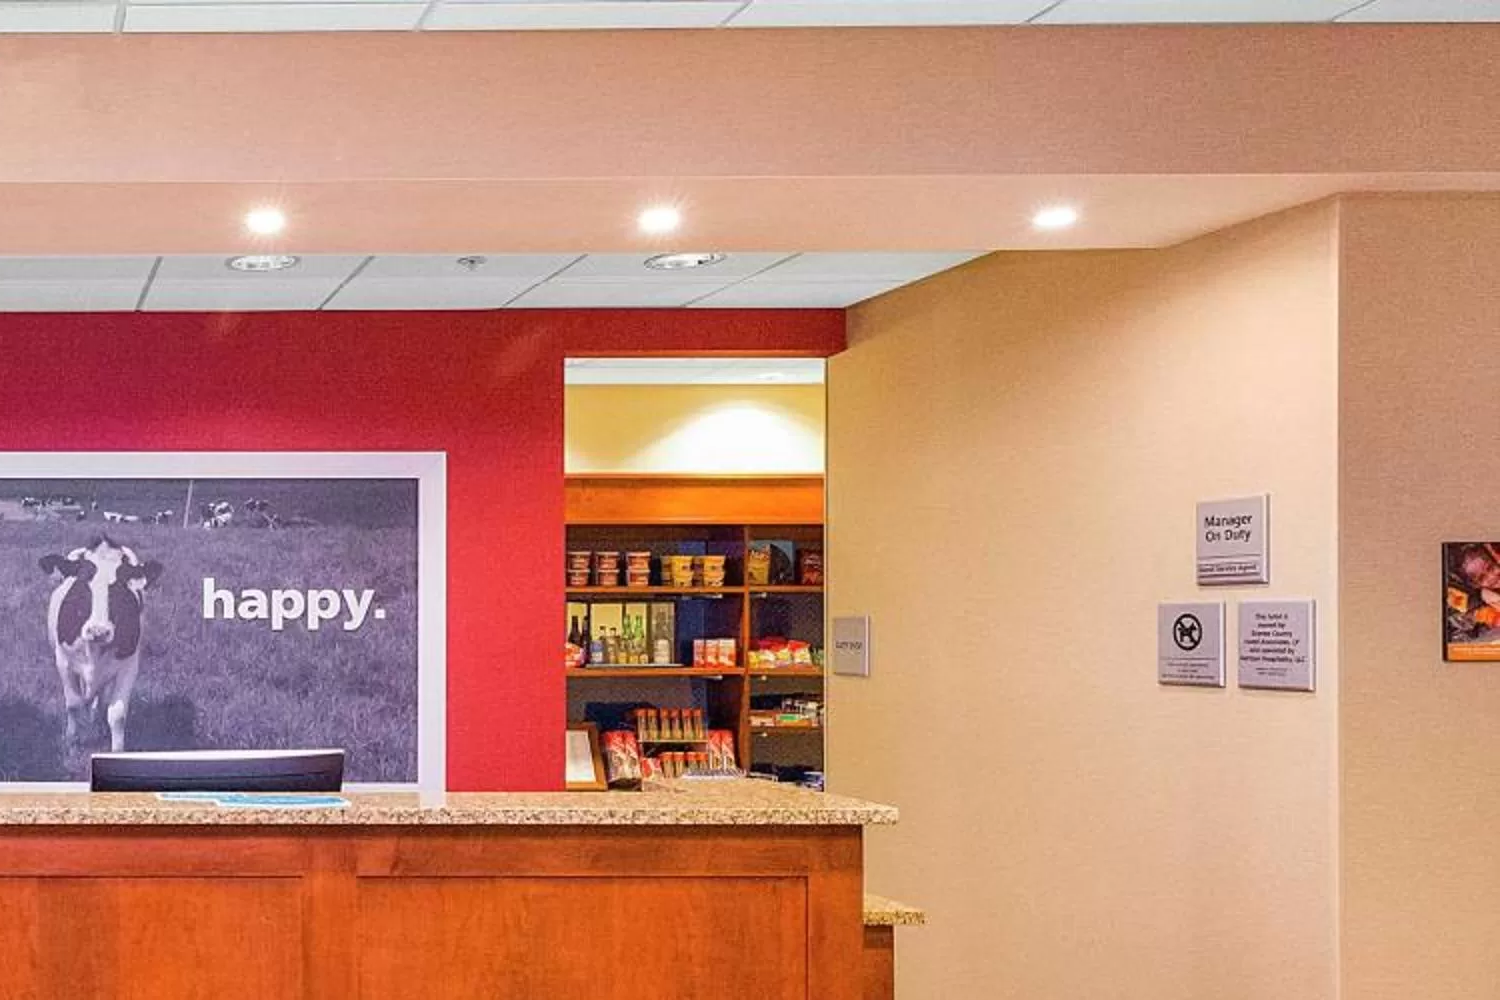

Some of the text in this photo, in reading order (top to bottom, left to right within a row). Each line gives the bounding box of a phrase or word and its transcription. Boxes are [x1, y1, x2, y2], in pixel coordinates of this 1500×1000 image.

[1204, 514, 1252, 528] Manager
[1205, 529, 1252, 543] On Duty
[203, 577, 386, 631] happy.
